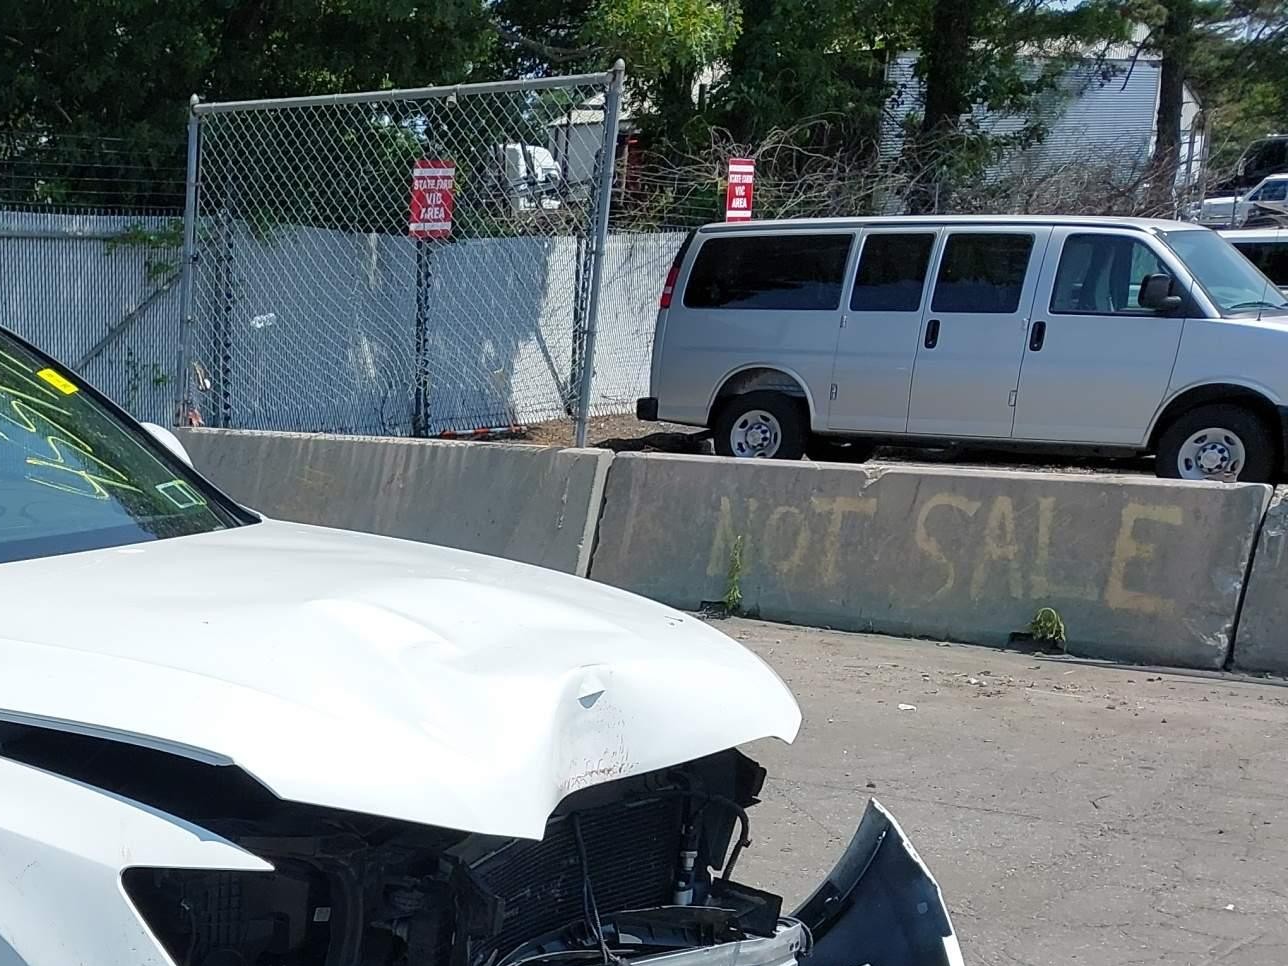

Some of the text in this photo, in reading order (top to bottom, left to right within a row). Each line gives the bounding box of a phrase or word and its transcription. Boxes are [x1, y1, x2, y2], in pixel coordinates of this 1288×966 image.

[732, 197, 747, 208] AREA
[420, 207, 445, 219] AREA
[912, 491, 1185, 611] SALE
